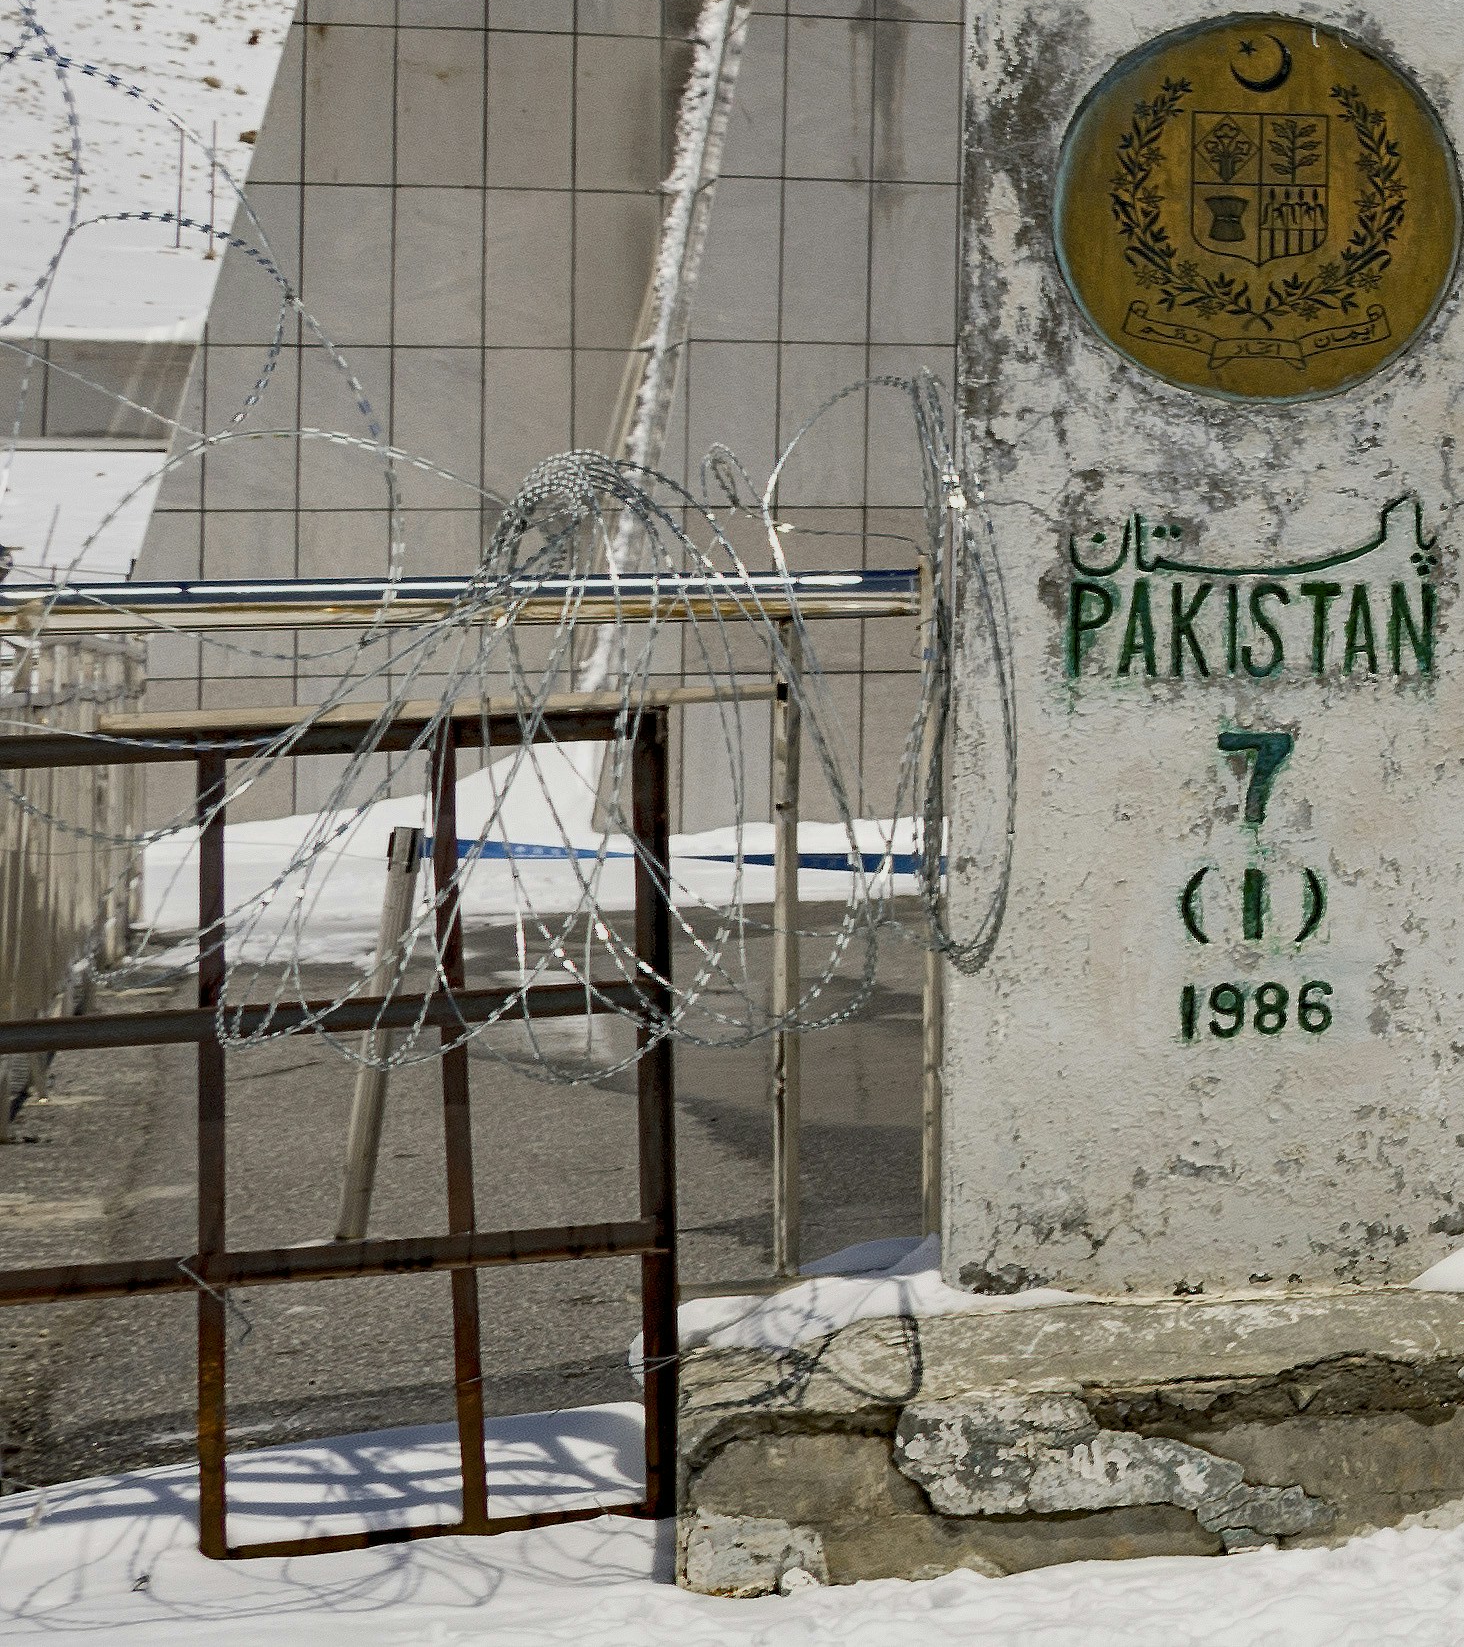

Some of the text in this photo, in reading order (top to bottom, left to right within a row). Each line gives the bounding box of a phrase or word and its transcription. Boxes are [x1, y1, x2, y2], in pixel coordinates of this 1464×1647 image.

[1069, 489, 1438, 577] پاکستان
[1066, 578, 1437, 677] PAKISTAN
[1217, 731, 1293, 825] 7
[1179, 980, 1334, 1041] 1986
